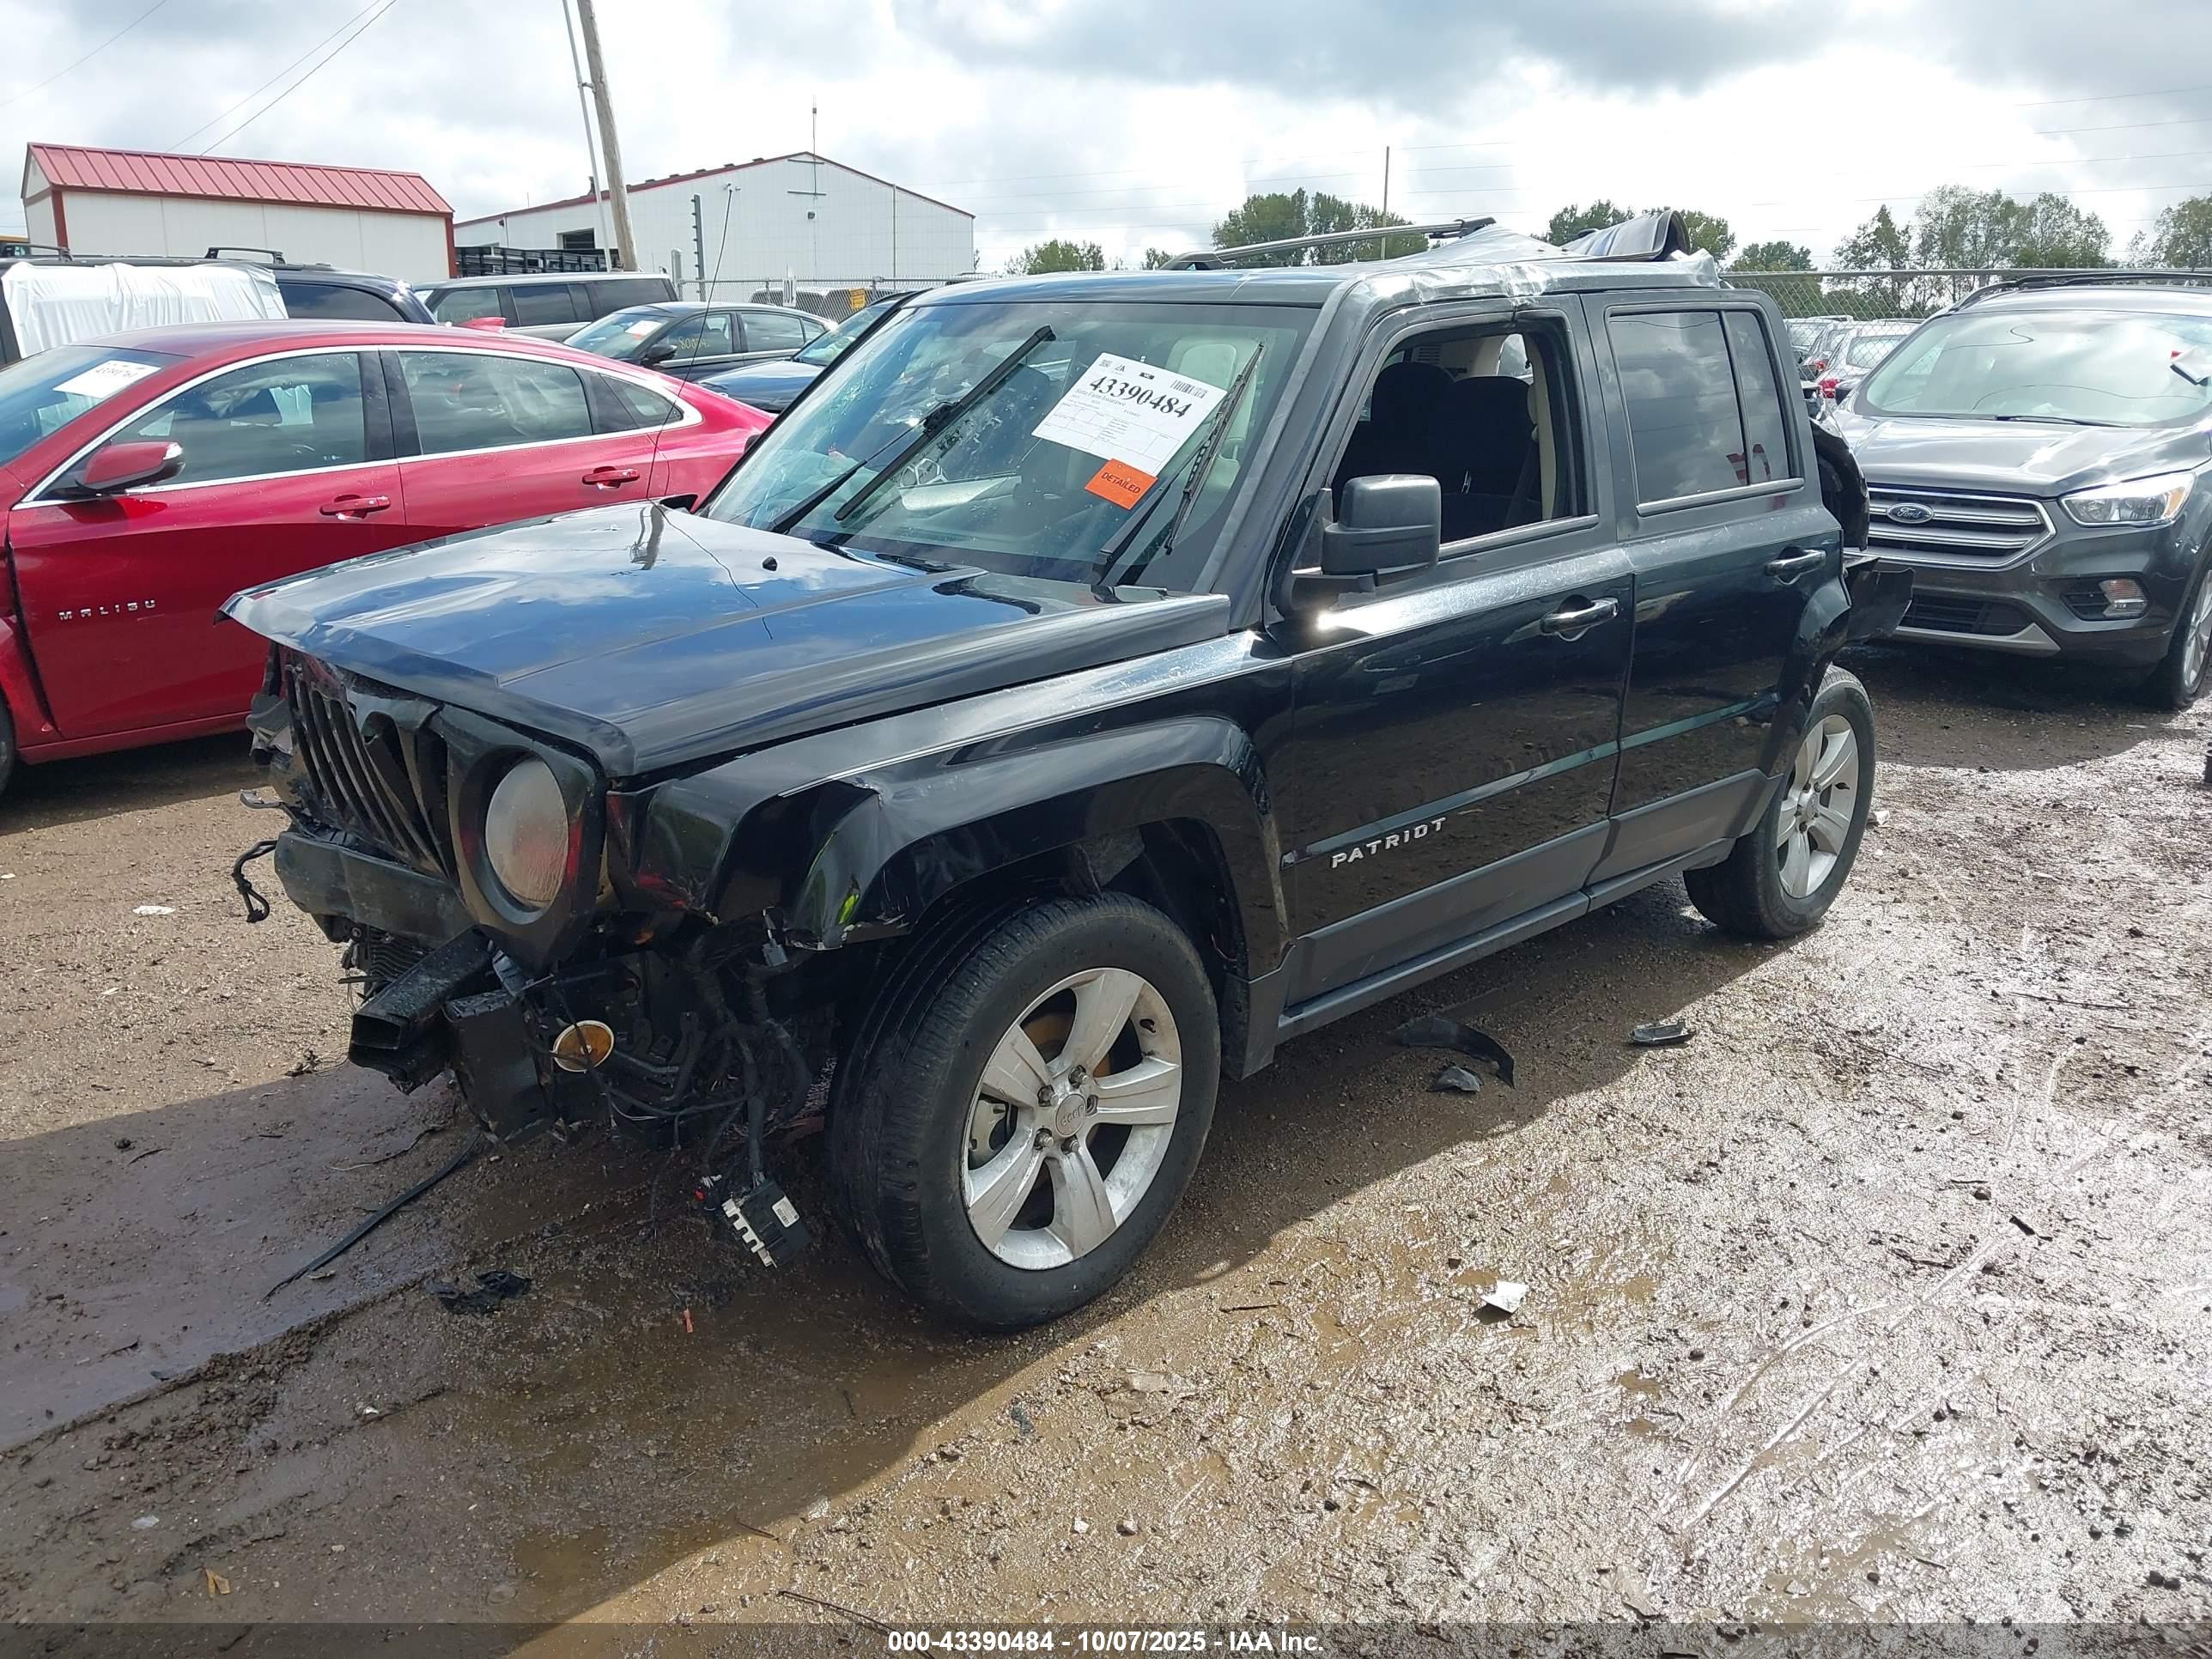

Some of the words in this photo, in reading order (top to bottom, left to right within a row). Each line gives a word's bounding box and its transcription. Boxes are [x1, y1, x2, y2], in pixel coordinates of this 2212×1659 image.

[1089, 376, 1192, 417] 43390484
[1101, 471, 1141, 494] DETAILED
[1897, 507, 1922, 519] Ford
[58, 599, 155, 620] MALIBU
[1331, 817, 1447, 868] PATRIOT
